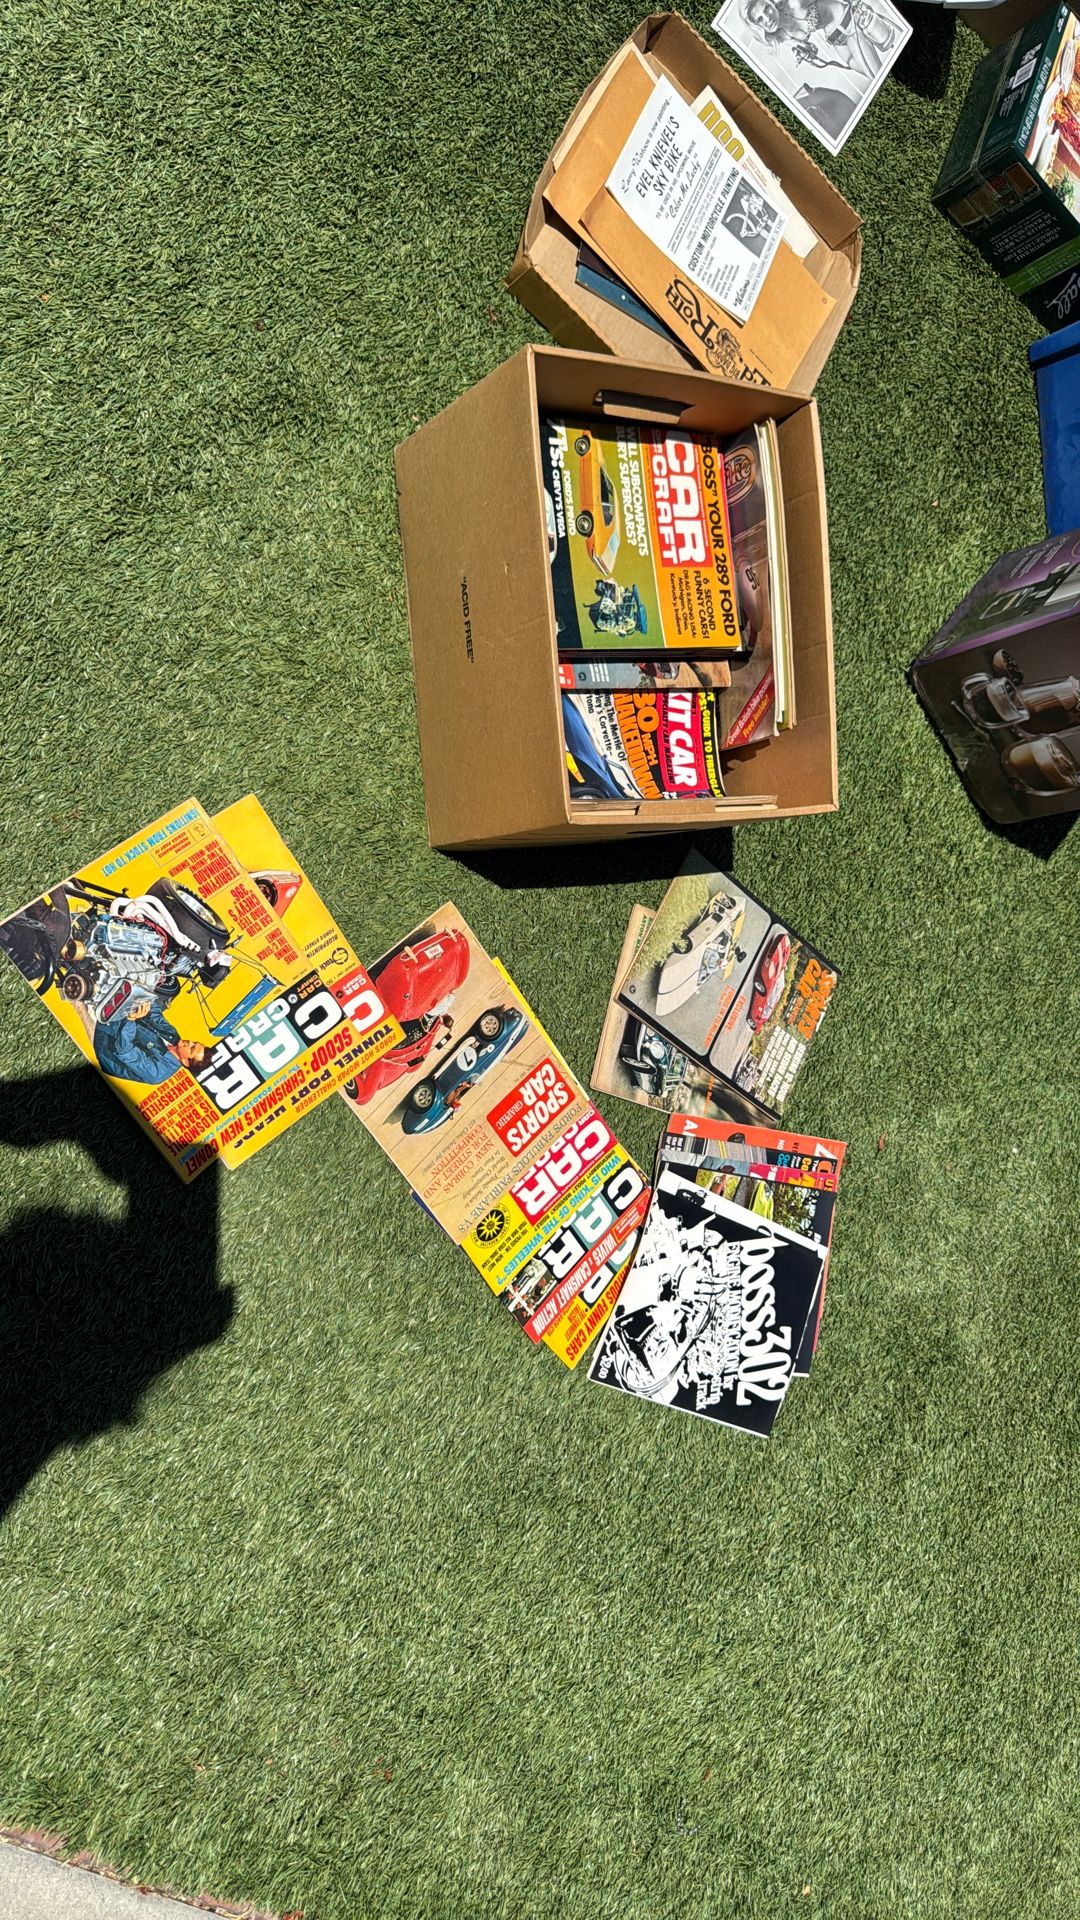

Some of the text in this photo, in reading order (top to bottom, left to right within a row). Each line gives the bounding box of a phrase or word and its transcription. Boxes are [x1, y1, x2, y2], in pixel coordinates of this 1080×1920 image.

[635, 115, 680, 198] EVEL KNIEVEL'S
[652, 142, 683, 196] SKY BIKE
[686, 241, 706, 271] CUSTOM
[700, 197, 726, 242] MOTORCYCLE
[720, 166, 740, 199] PAINTING
[618, 463, 636, 545] SUPERCARS?
[628, 460, 648, 555] SUBCOMPACTS
[650, 454, 677, 565] CRAFT
[664, 430, 705, 564] CAR
[555, 511, 566, 537] VEGA
[565, 504, 577, 535] PINTO
[707, 500, 724, 549] YOUR
[682, 570, 690, 590] DRAG
[713, 553, 729, 585] 289
[685, 592, 694, 620] RACING
[693, 570, 709, 639] FUNNY CARS!
[703, 588, 715, 630] SECOND
[718, 589, 736, 636] FORD
[605, 707, 626, 761] The Mettle Of
[632, 691, 661, 766] 30 MPH
[668, 692, 697, 785] KIT CAR
[701, 709, 712, 738] GUIDE
[612, 692, 662, 799] HAKEDOWN
[704, 739, 712, 751] TO
[663, 746, 674, 784] MAGAZINE
[101, 807, 200, 877] IGNITIONS FROM STOCK TO HOT
[168, 839, 219, 877] FOUR-WHEEL SMOKER
[192, 853, 231, 885] TORONADO
[197, 865, 240, 899] TERRIFYING
[227, 892, 261, 922] CHEVY'S
[237, 904, 266, 930] ROAD TEST
[245, 913, 273, 937] CAR CLUB
[264, 927, 282, 943] COMET
[273, 942, 293, 960] TUNING
[275, 935, 287, 946] THE
[305, 933, 338, 959] BLUEPRINTIN
[283, 950, 298, 964] DRAG
[295, 973, 318, 993] CRAFT
[298, 977, 322, 999] CAR
[341, 973, 362, 990] CRAFT
[344, 977, 366, 995] CAR
[196, 998, 290, 1082] CRAFT
[202, 992, 342, 1109] CAR
[302, 1026, 354, 1076] SCOOP:
[333, 1023, 392, 1071] TUNNEL
[294, 1032, 396, 1113] FORD'S HOT MOPAR CHALLENGER
[461, 1051, 474, 1067] 7
[134, 1069, 186, 1111] FUEL GAS CHAMPS
[140, 1076, 194, 1121] BAKERSFIELD
[182, 1095, 192, 1104] GAS
[243, 1068, 306, 1126] CHRISMAN'S
[288, 1068, 332, 1105] PORT
[517, 1061, 558, 1106] CAR
[166, 1107, 177, 1118] TONY
[198, 1099, 212, 1113] IS
[495, 1098, 523, 1129] GRAPHIC
[505, 1080, 570, 1153] SPORTS
[552, 1102, 582, 1133] FORD'S
[167, 1109, 220, 1156] OLDSMOBILE
[220, 1118, 246, 1146] NEW
[429, 1123, 483, 1178] COMPETITION
[474, 1139, 494, 1162] NEW
[183, 1138, 220, 1176] COMET
[422, 1131, 488, 1199] FOR STREET AND
[510, 1130, 554, 1177] FABULOUS
[516, 1120, 610, 1215] CAR
[599, 1154, 621, 1177] WHO
[442, 1159, 474, 1194] COBRAS
[590, 1173, 602, 1186] IS
[469, 1173, 512, 1220] FAIRLANE
[557, 1205, 571, 1220] OF
[540, 1216, 559, 1237] THE
[541, 1167, 642, 1278] CAR
[592, 1232, 616, 1266] VALVES
[555, 1260, 592, 1306] CAMSHAFT
[531, 1298, 560, 1332] ACTION
[582, 1298, 608, 1335] FUNNY
[564, 1329, 588, 1360] CARS
